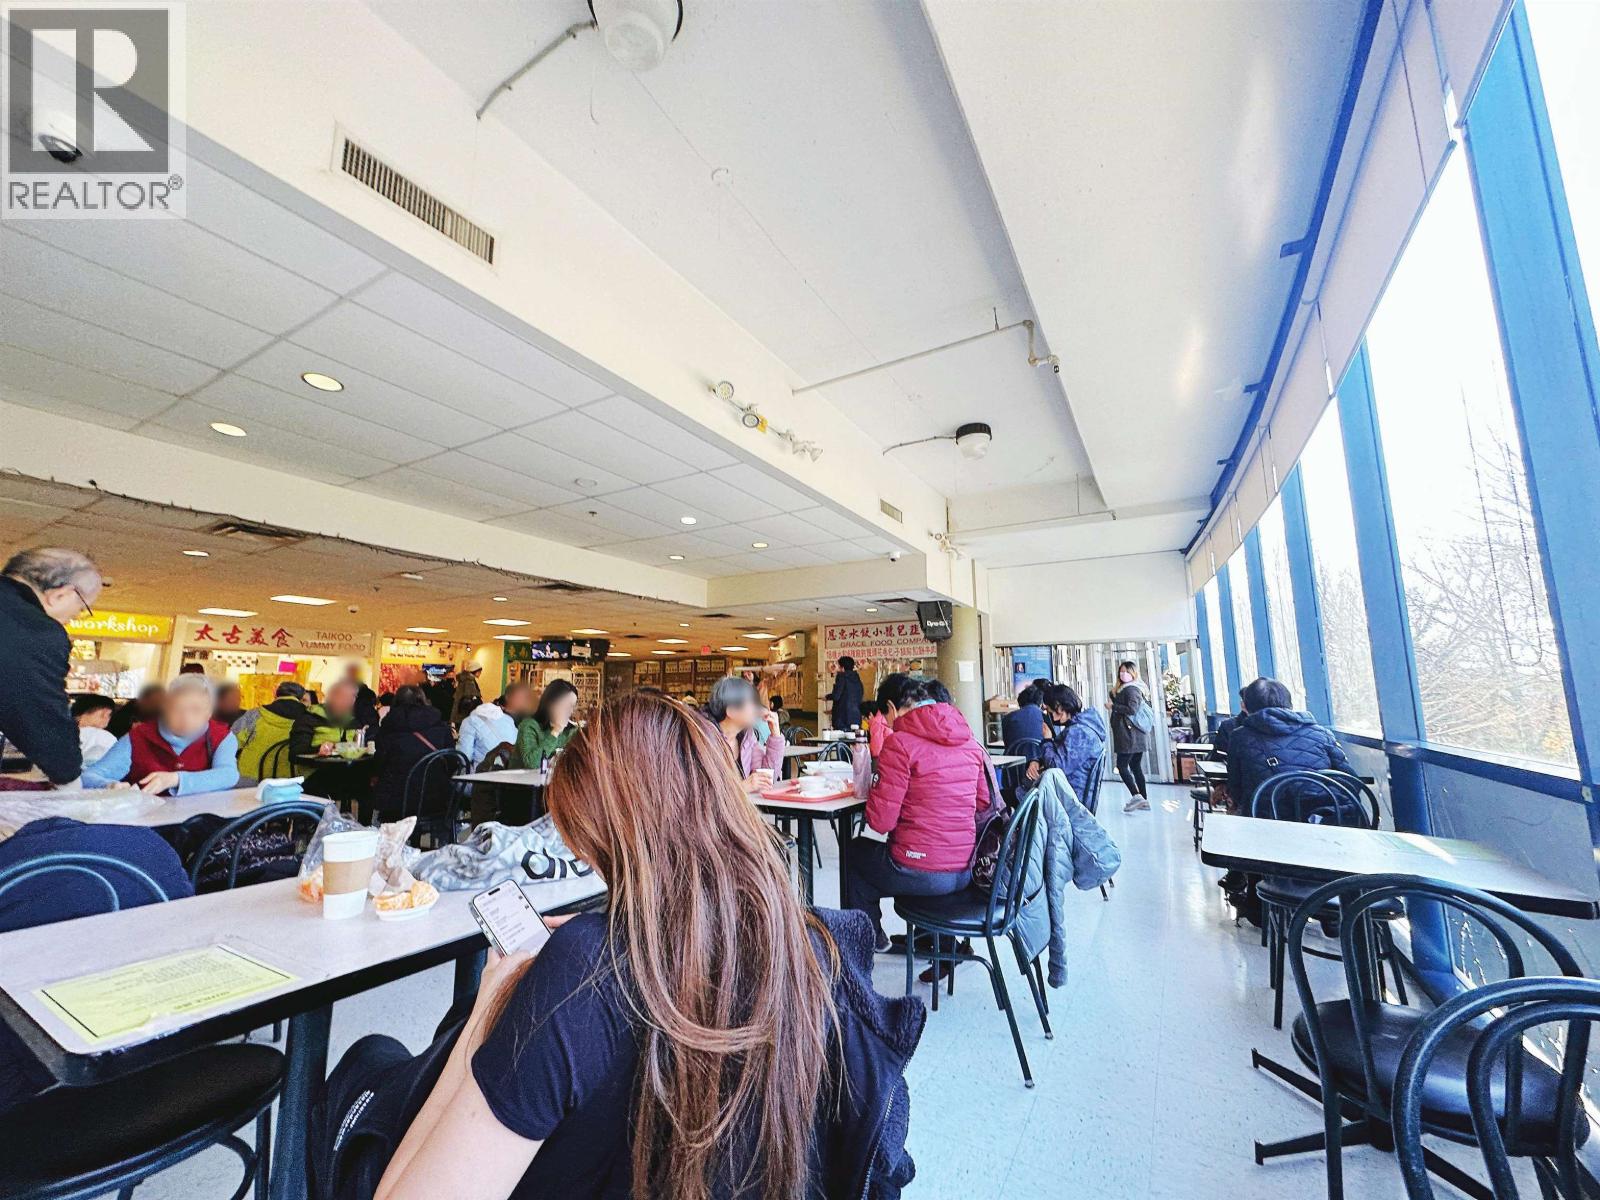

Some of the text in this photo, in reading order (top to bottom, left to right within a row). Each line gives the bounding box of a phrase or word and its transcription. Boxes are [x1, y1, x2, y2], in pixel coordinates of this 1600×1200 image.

[69, 614, 159, 637] workshop
[194, 623, 293, 648] 太古美食
[316, 631, 353, 641] TAIKOO
[299, 640, 366, 651] YUMMY FOOD
[840, 641, 866, 649] GRACE
[870, 639, 893, 647] FOOD
